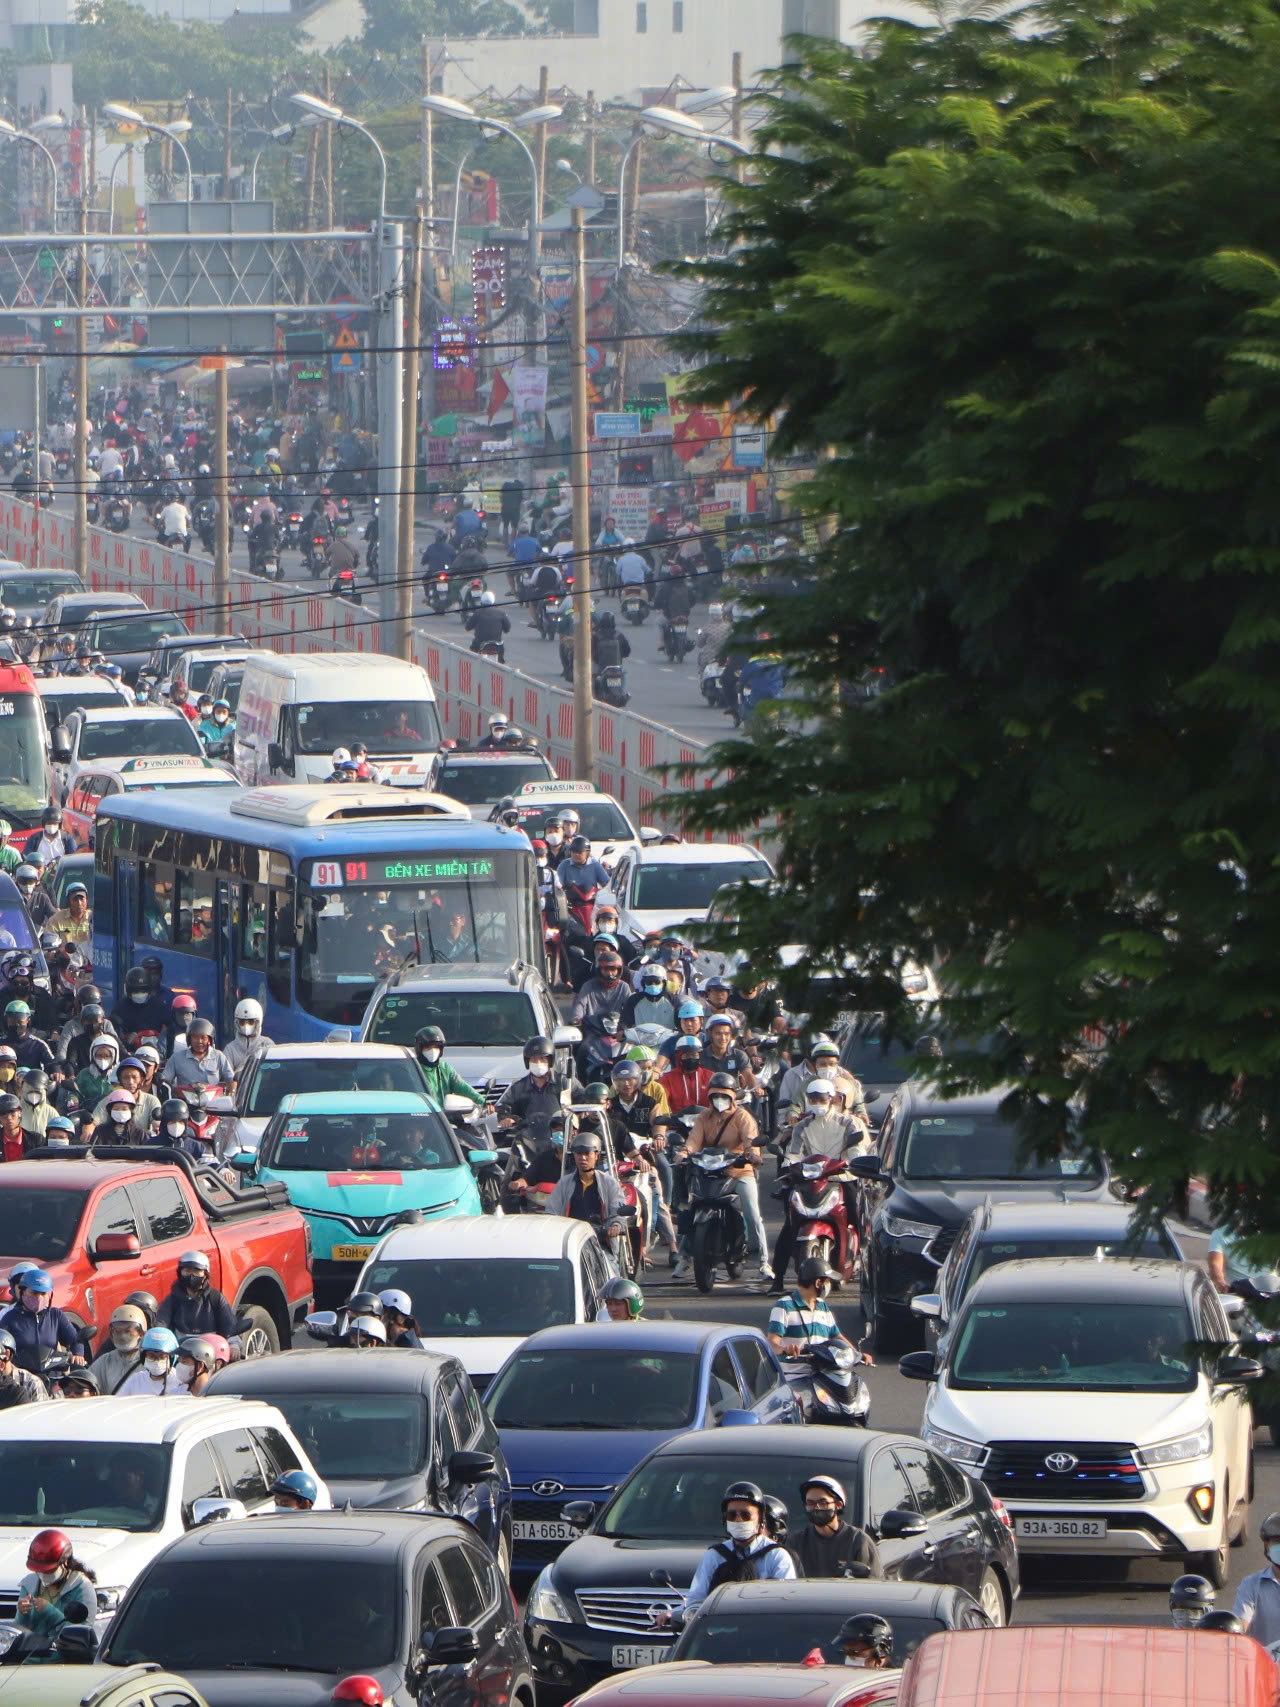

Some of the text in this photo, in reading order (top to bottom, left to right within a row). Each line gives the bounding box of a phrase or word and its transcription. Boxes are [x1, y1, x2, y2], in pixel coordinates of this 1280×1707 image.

[318, 864, 336, 885] 91
[346, 862, 368, 881] 91
[385, 862, 412, 878] BẾN
[415, 864, 433, 877] XE
[436, 859, 468, 876] MIỀN
[339, 1248, 373, 1258] 50H-4
[1023, 1522, 1099, 1534] 93A-360.82
